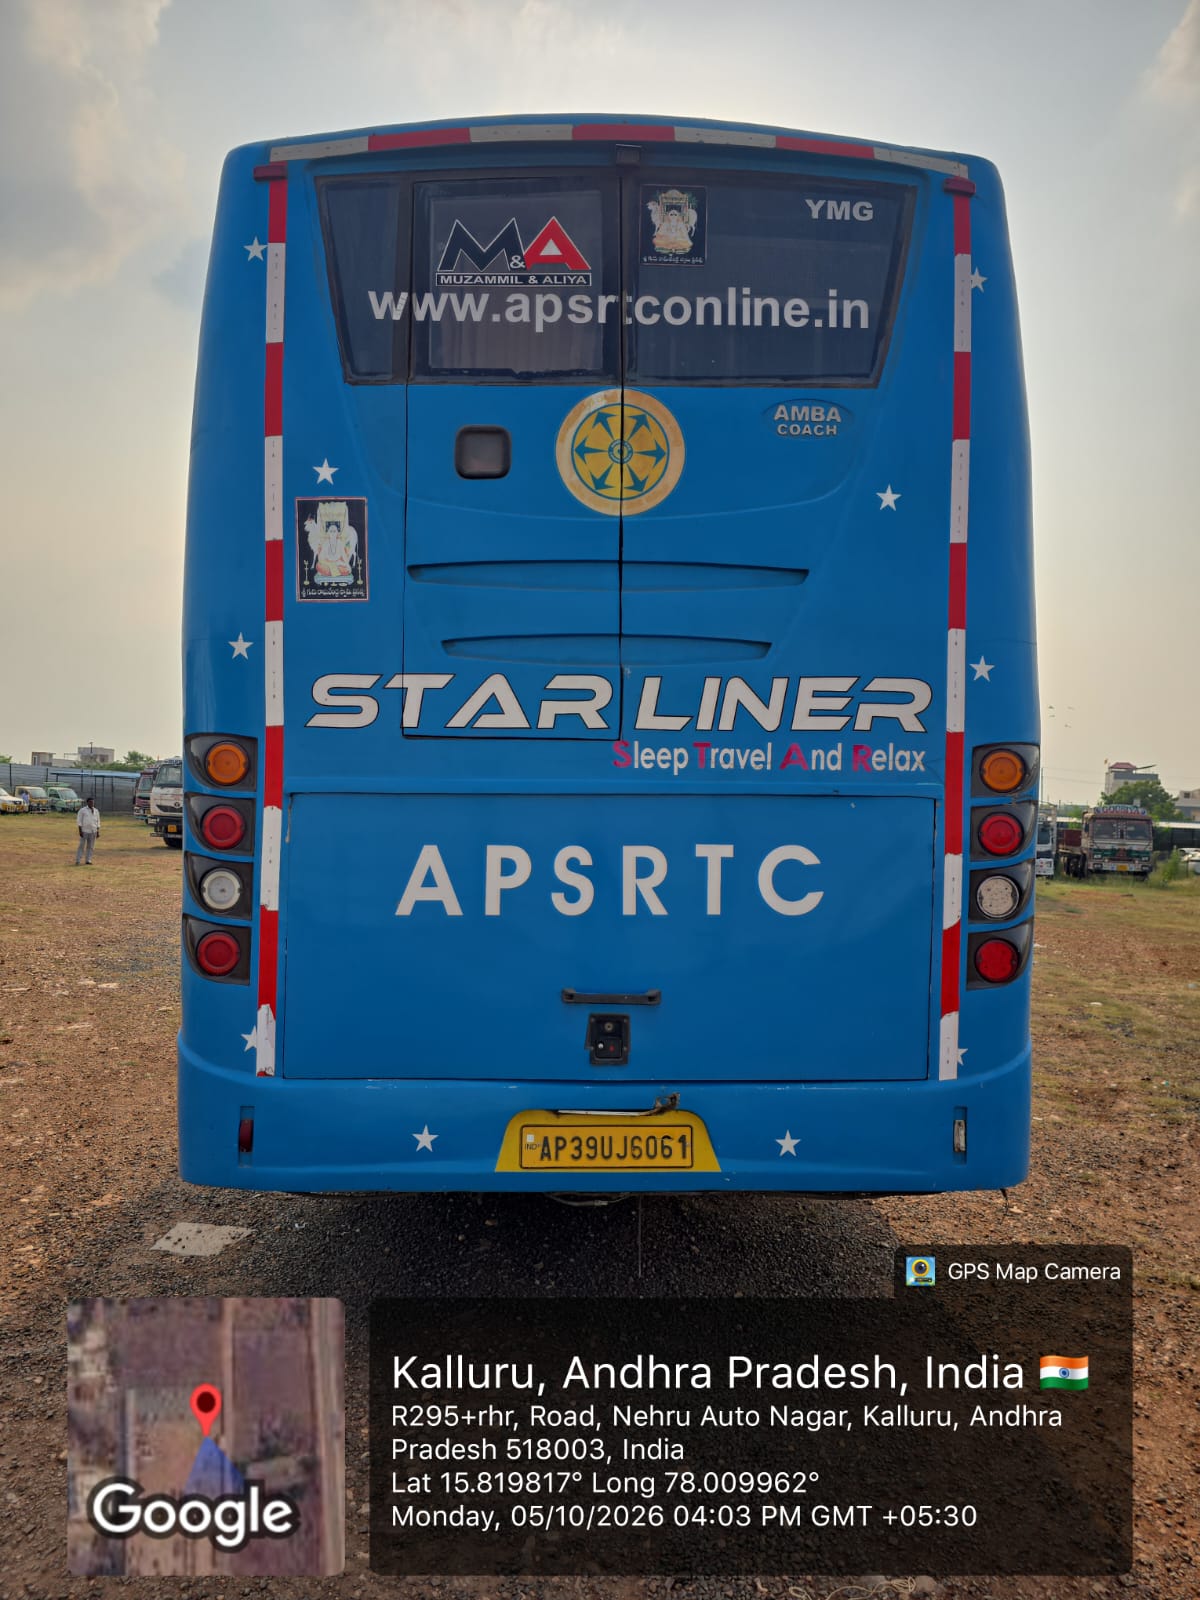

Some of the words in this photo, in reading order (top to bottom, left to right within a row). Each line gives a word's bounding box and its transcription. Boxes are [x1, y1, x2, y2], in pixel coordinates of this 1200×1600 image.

[804, 198, 874, 221] YMG
[439, 274, 523, 285] MUZAMMIL
[527, 275, 539, 285] &
[542, 275, 588, 285] ALIYA
[367, 286, 870, 333] www.apsrtconline.in
[773, 404, 842, 423] AMBA
[777, 423, 838, 436] COACH
[303, 673, 614, 730] STAR
[633, 675, 933, 733] LINER
[612, 740, 689, 776] Sleep
[693, 741, 772, 771] Travel
[779, 742, 842, 772] And
[852, 742, 926, 773] Relax
[394, 843, 826, 917] APSRTC
[540, 1134, 688, 1161] AP39UJ6061
